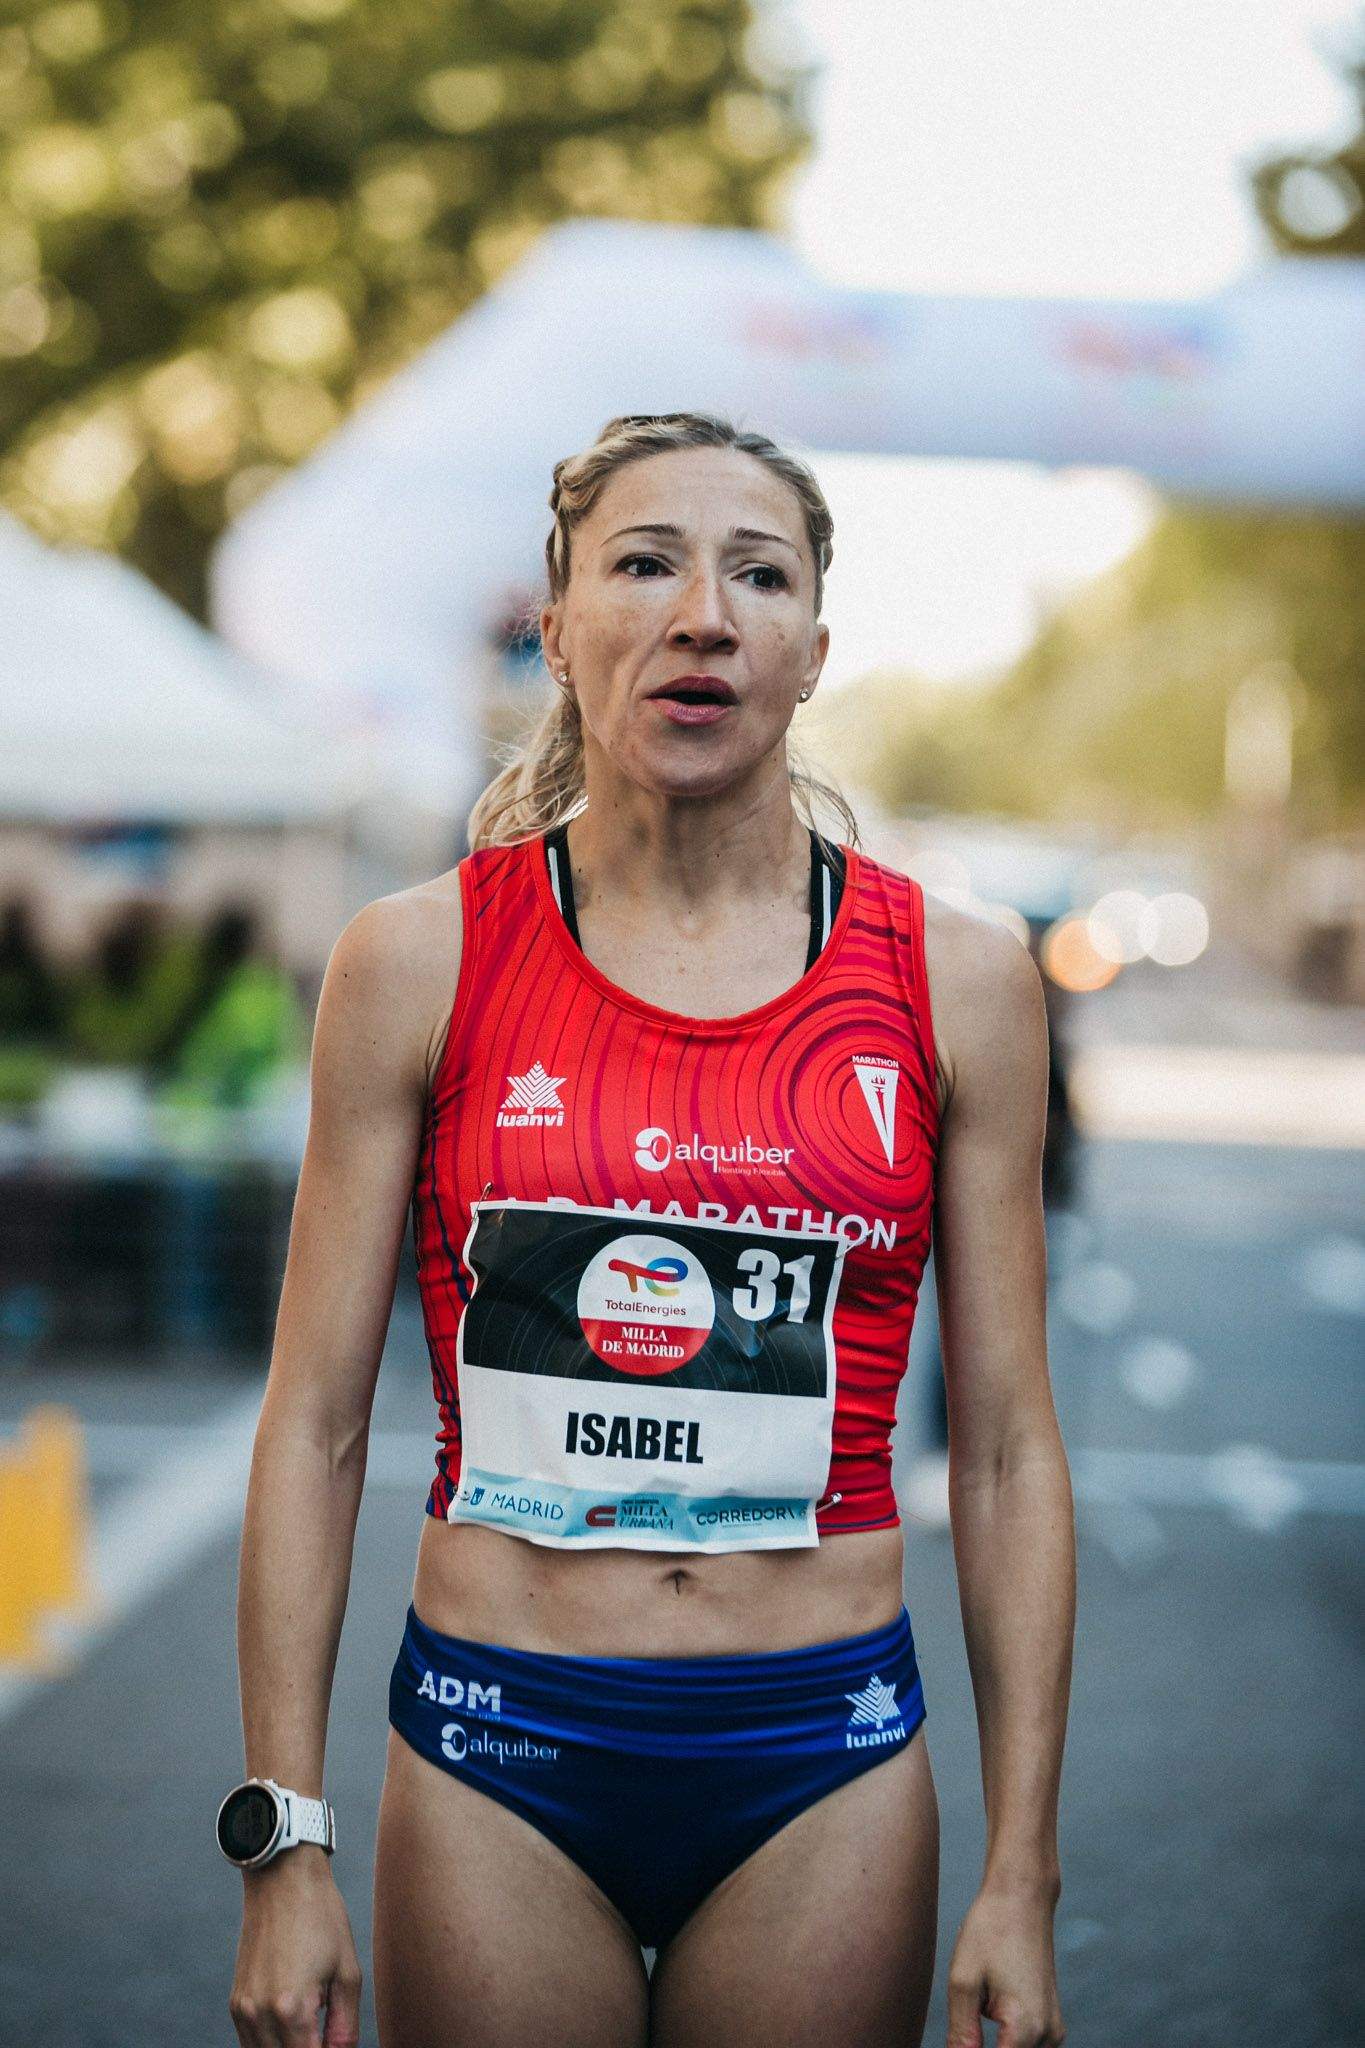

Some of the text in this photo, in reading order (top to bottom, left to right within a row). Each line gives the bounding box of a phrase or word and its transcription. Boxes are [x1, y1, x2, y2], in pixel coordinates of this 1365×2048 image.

[852, 1055, 899, 1069] MARATHON
[496, 1111, 564, 1128] luanvi
[675, 1133, 795, 1173] alquiber
[732, 1248, 816, 1324] 31
[605, 1299, 687, 1317] TotalEnergies
[621, 1326, 668, 1342] MILLA
[602, 1339, 685, 1358] DE MADRID
[565, 1411, 704, 1464] ISABEL
[491, 1493, 564, 1520] MADRID
[417, 1670, 502, 1713] ADM
[846, 1721, 906, 1749] luanvi
